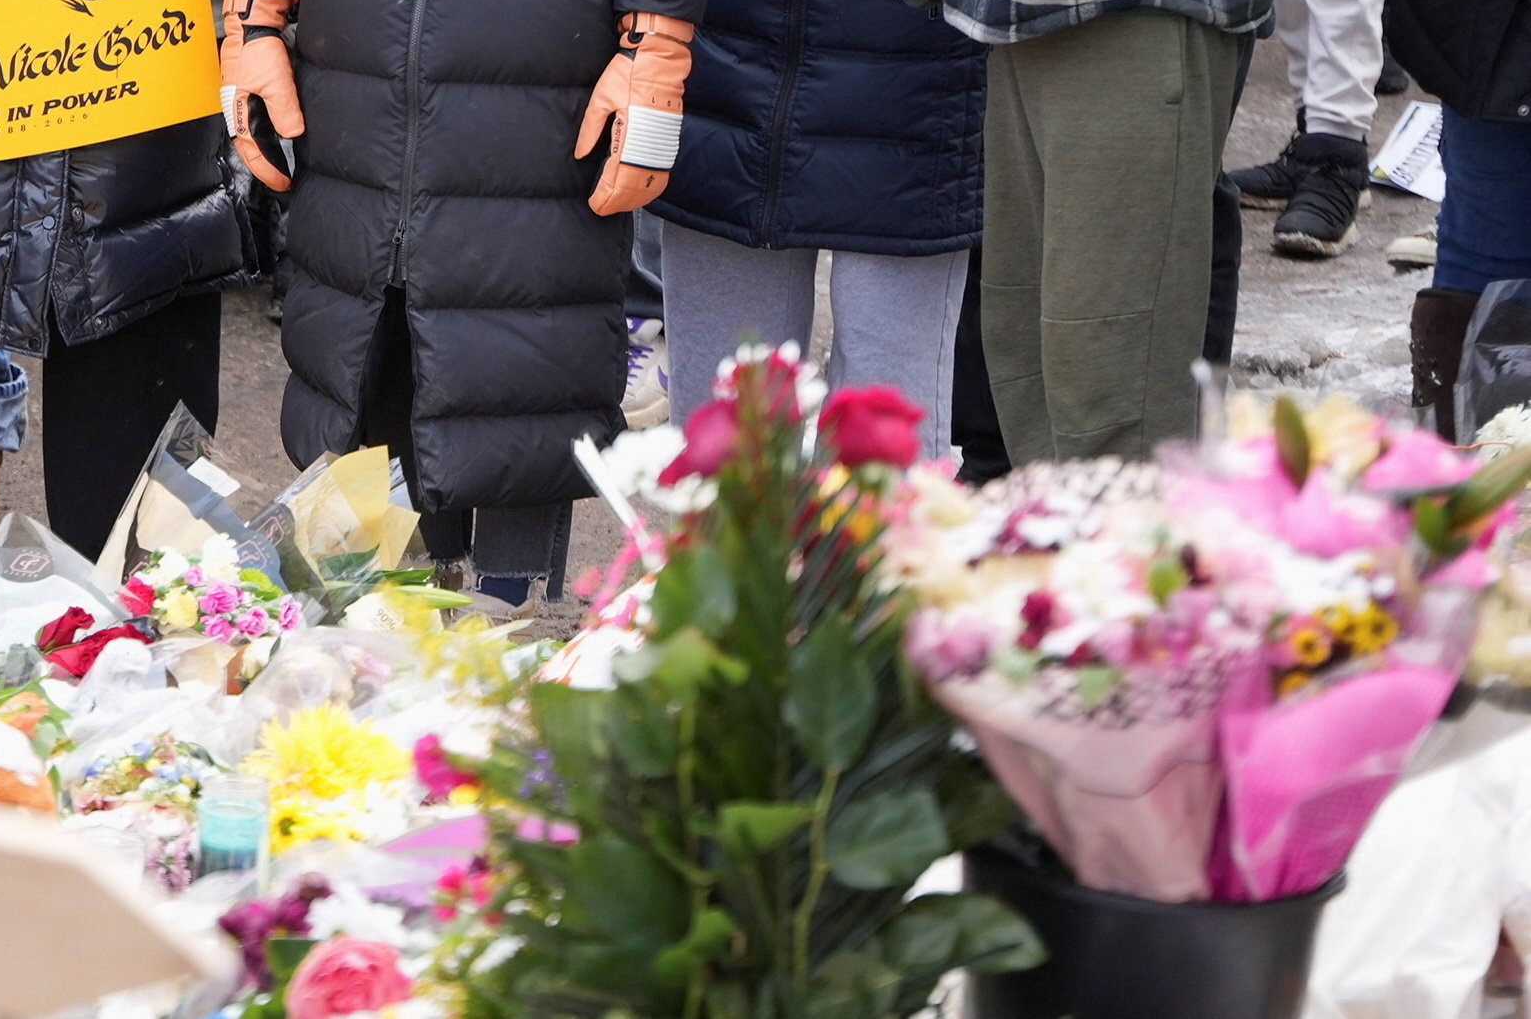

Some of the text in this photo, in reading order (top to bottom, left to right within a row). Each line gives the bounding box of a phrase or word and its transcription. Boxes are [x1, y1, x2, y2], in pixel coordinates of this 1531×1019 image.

[93, 9, 188, 72] Good
[8, 104, 34, 122] IN
[42, 80, 140, 118] POWER
